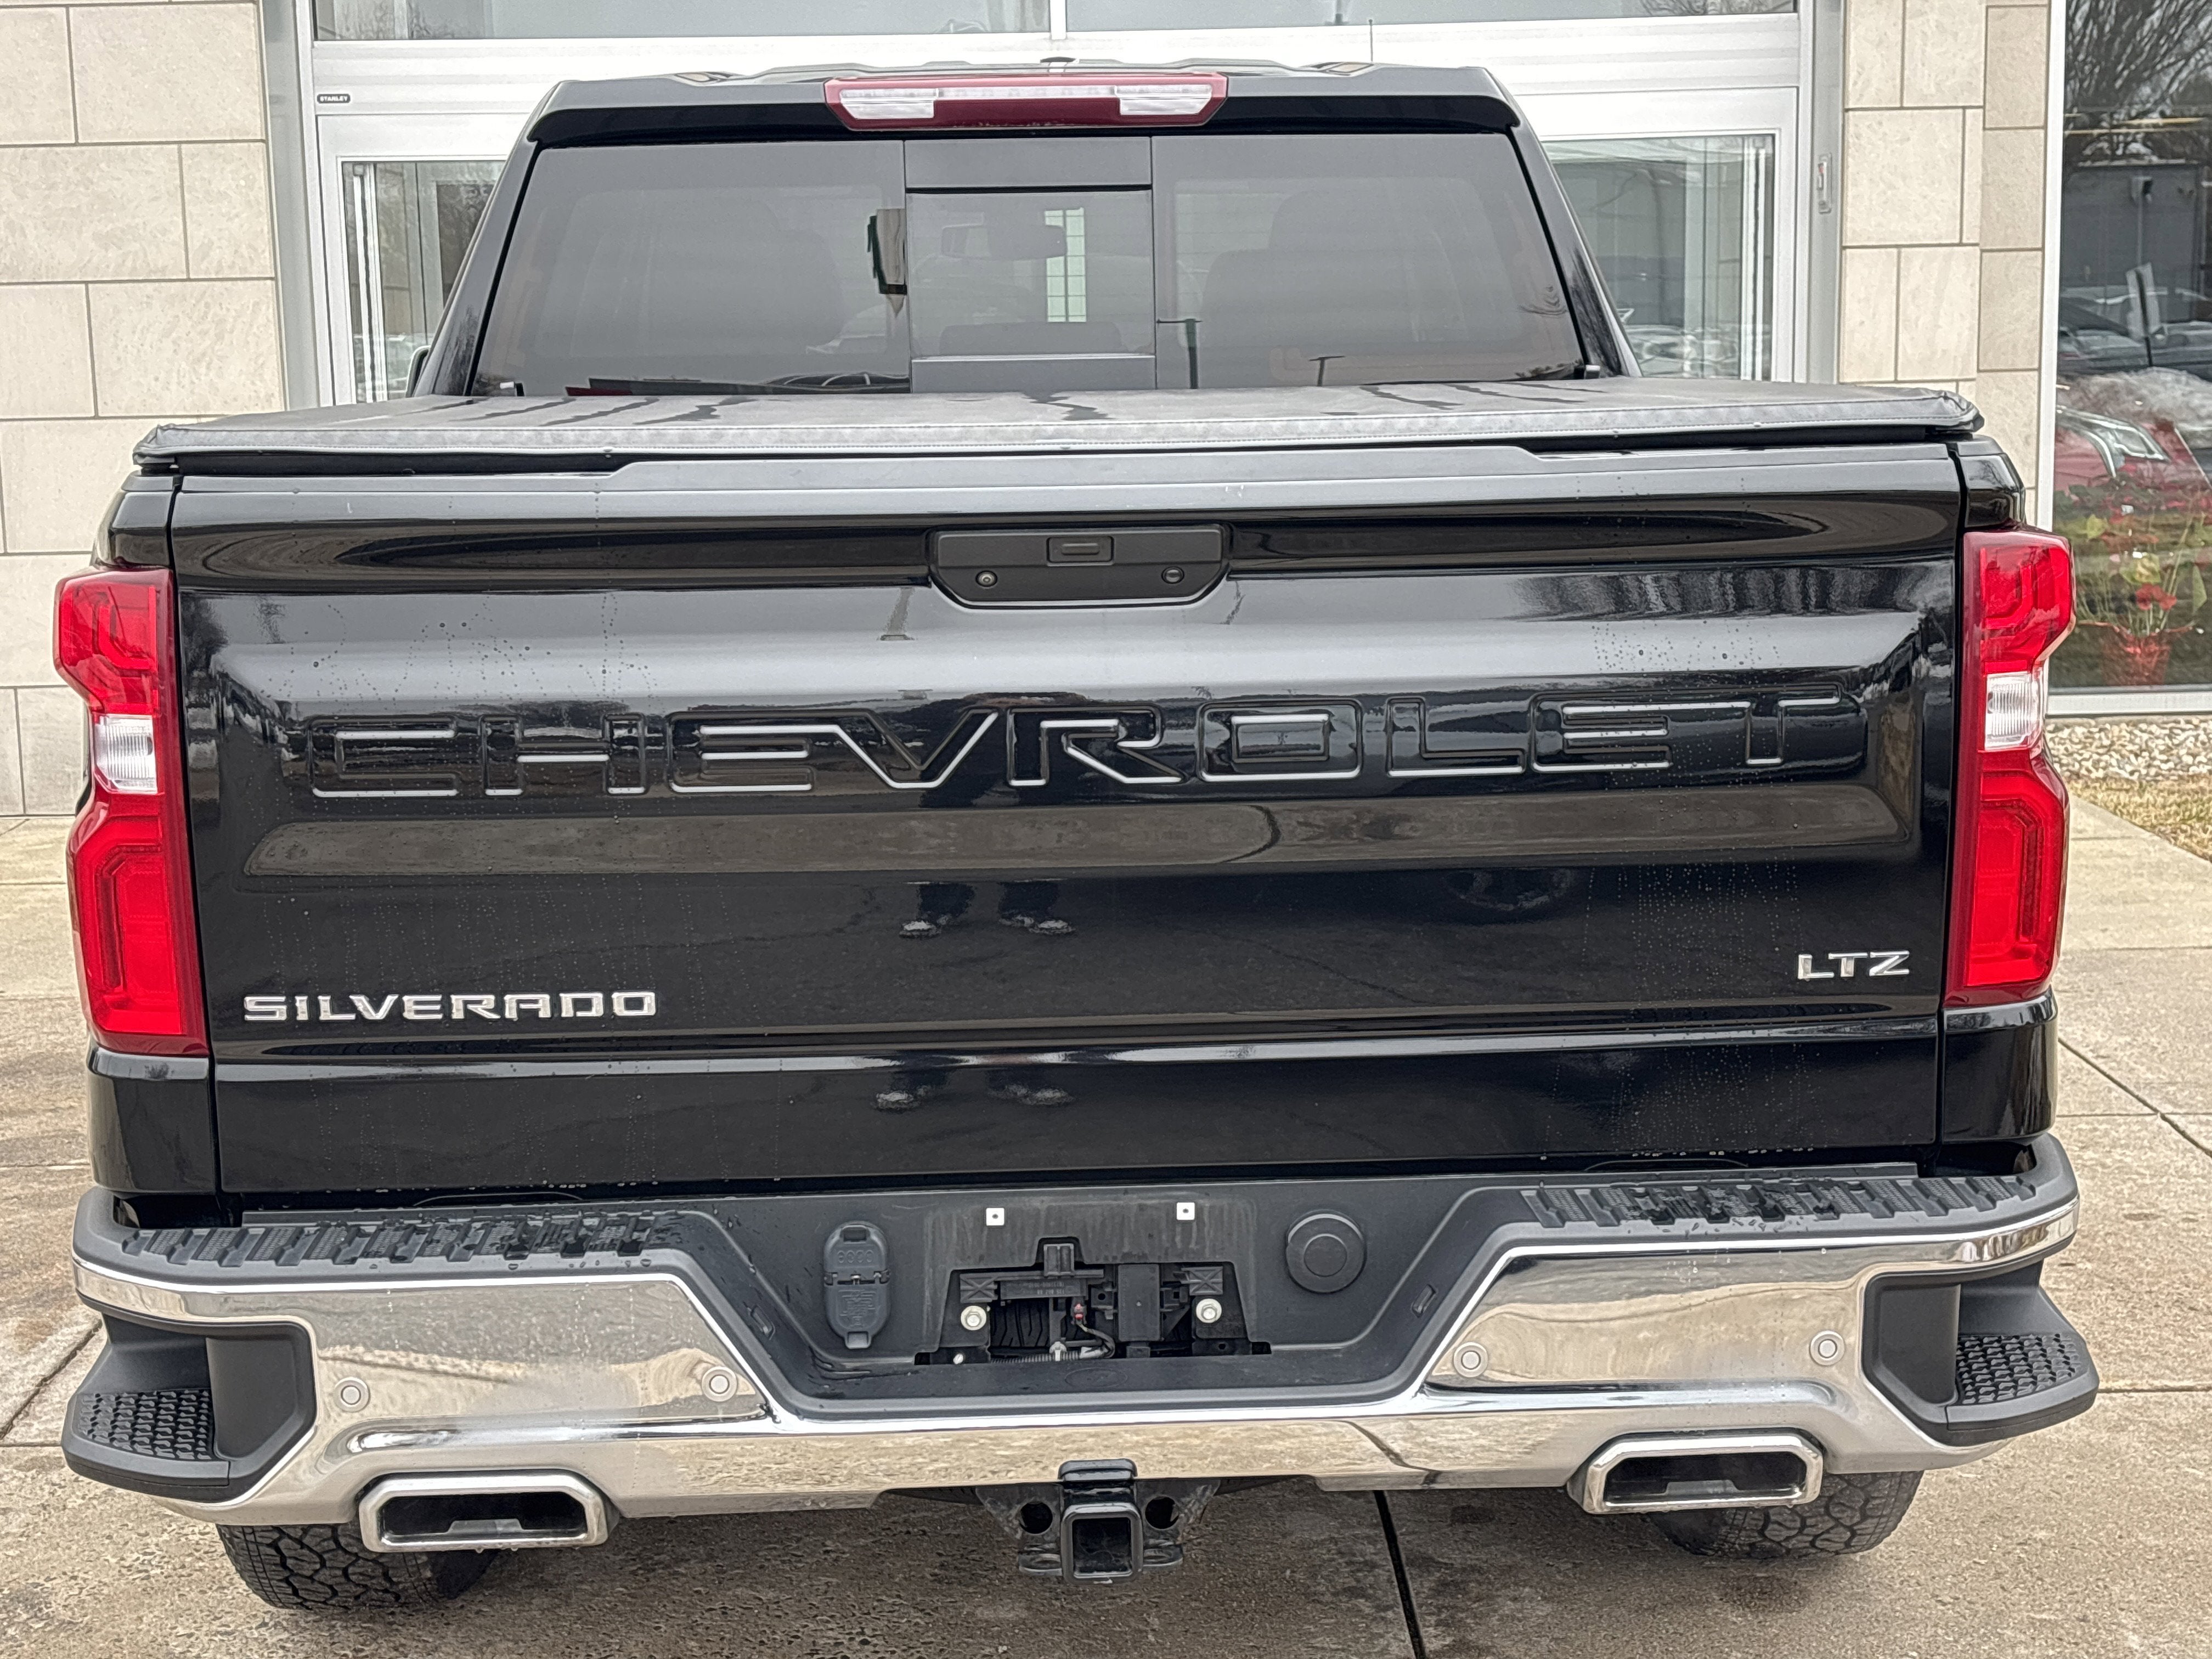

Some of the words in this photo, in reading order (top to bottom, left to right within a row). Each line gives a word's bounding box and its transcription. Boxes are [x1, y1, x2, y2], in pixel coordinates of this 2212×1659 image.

[309, 682, 1844, 797] CHEVROLET
[1797, 950, 1910, 980] LTZ
[243, 991, 657, 1021] SILVERADO
